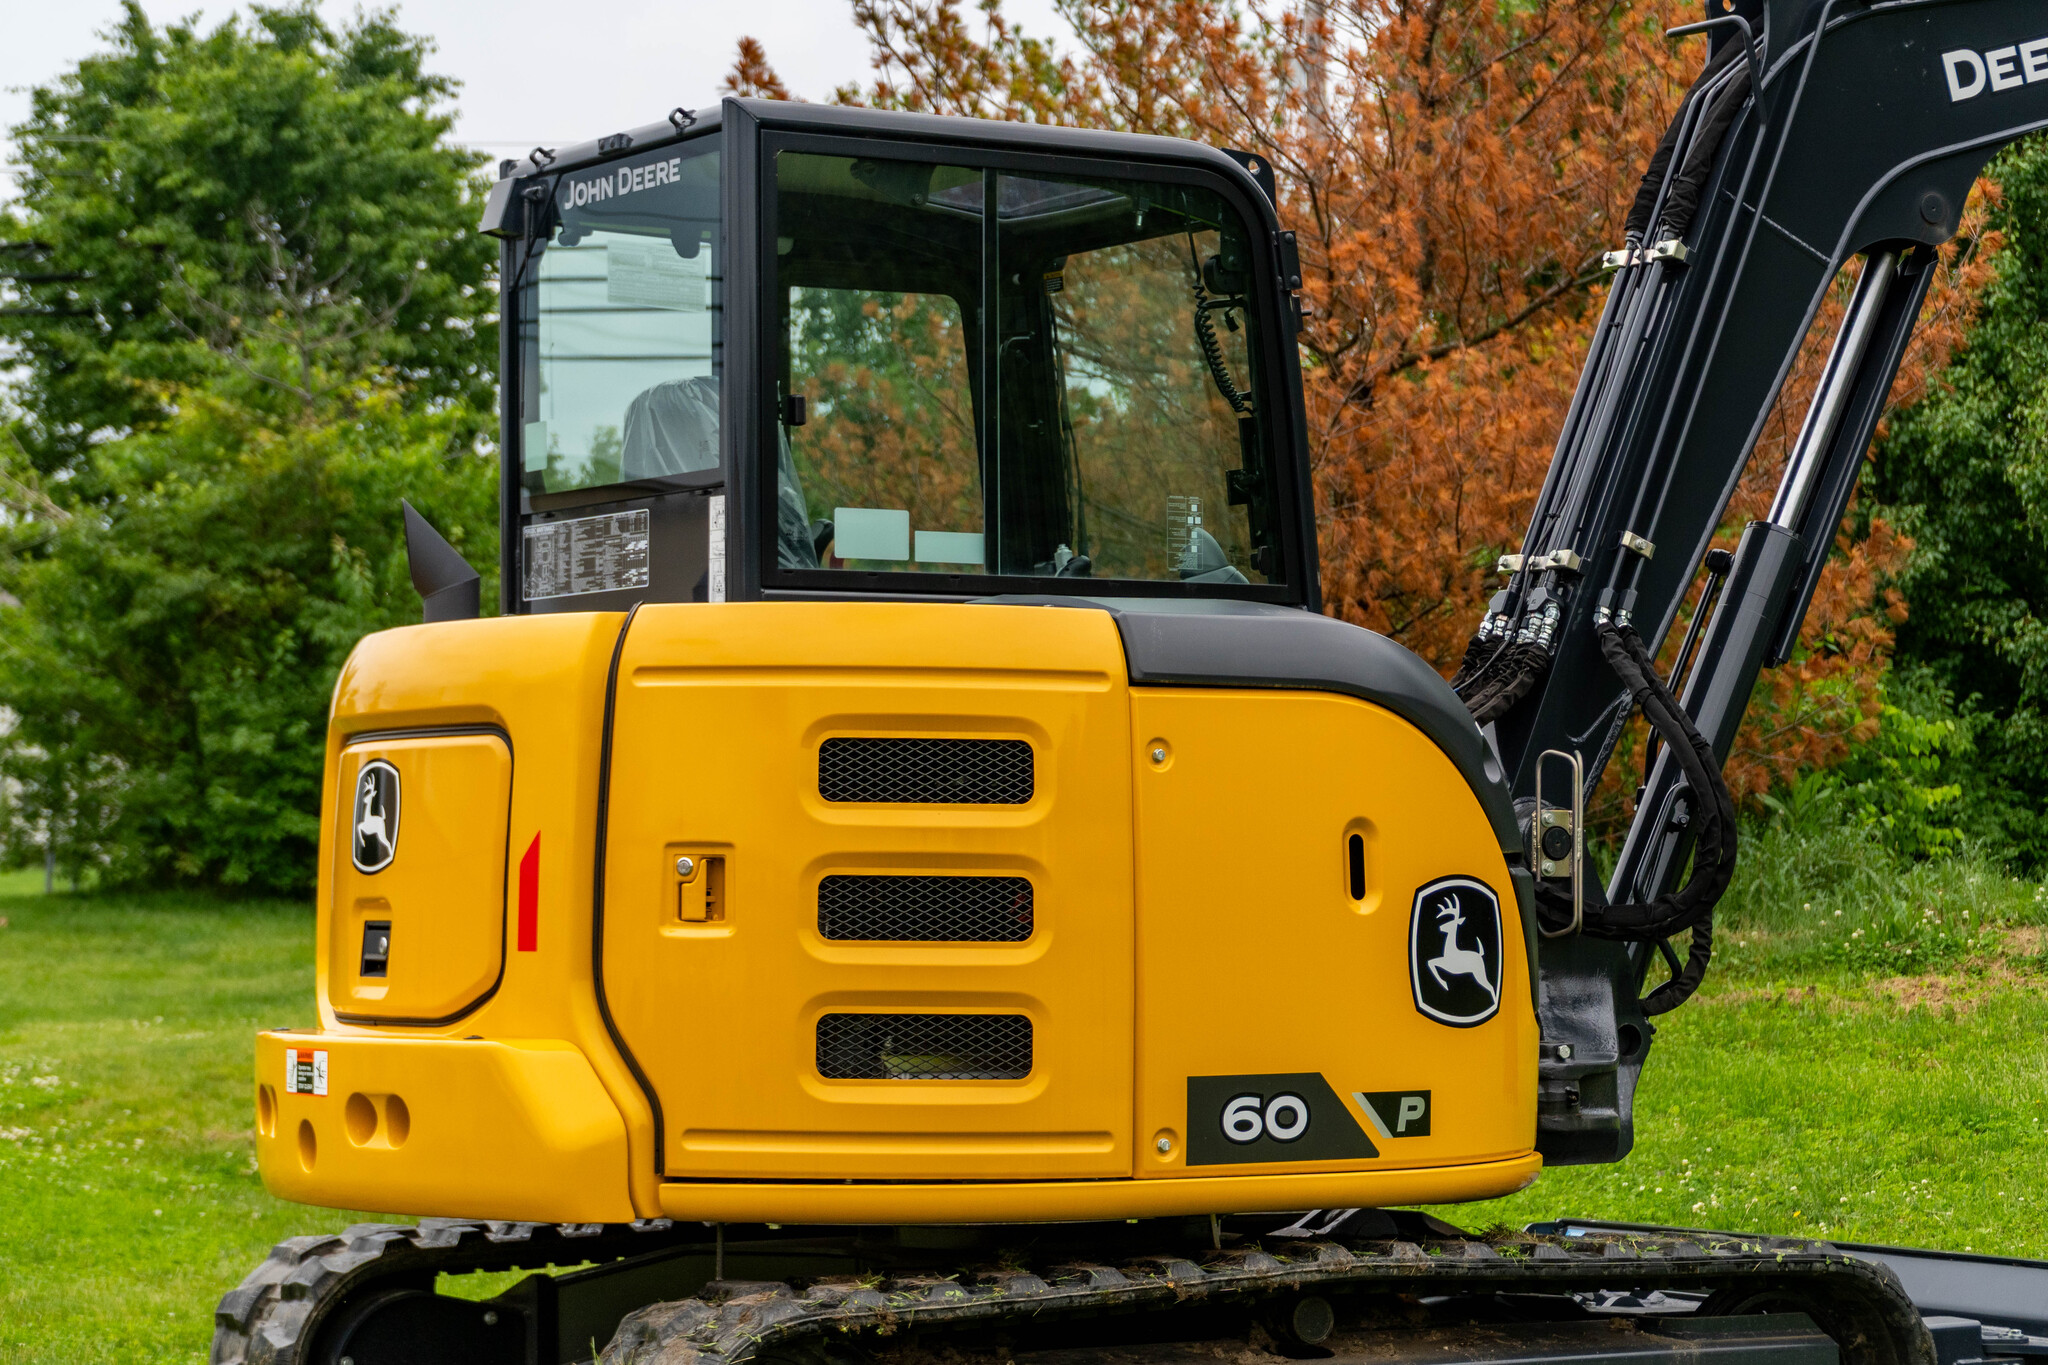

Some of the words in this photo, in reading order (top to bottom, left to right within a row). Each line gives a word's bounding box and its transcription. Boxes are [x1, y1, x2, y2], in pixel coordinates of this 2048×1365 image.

[1941, 37, 2048, 102] DEE
[564, 175, 614, 210] JOHN
[618, 157, 681, 196] DEERE
[1222, 1095, 1309, 1142] 60
[1396, 1096, 1426, 1132] P
